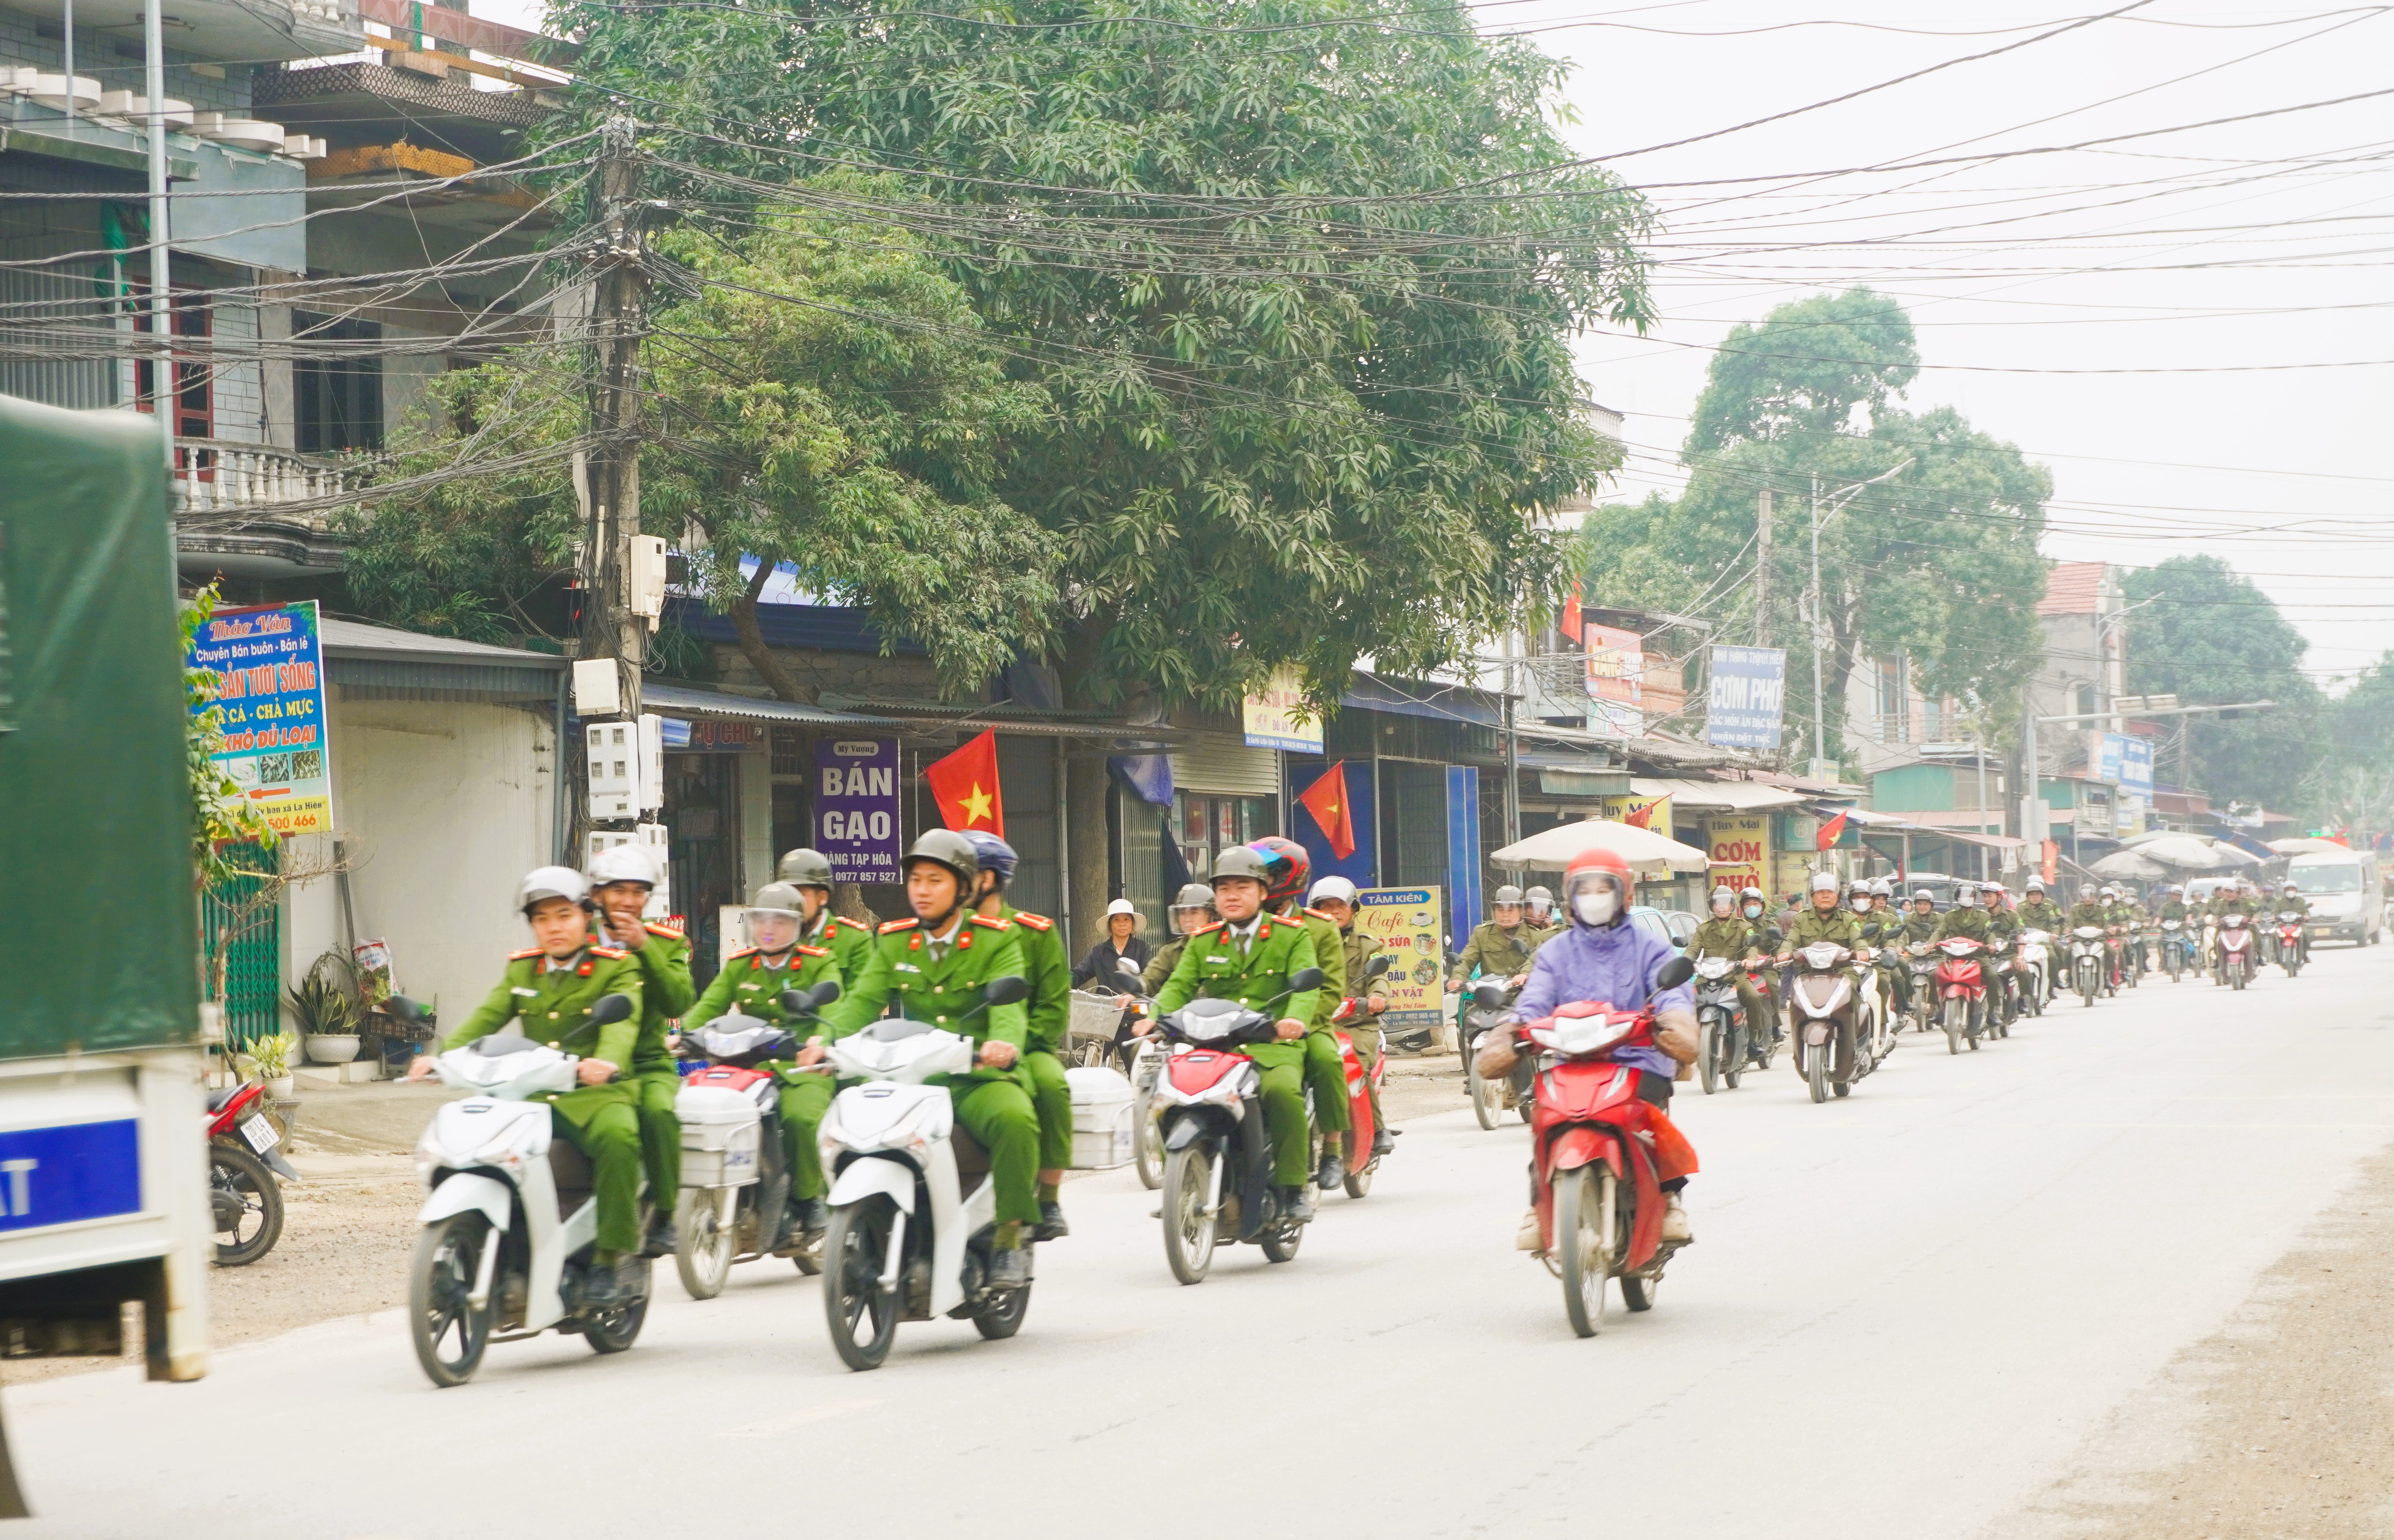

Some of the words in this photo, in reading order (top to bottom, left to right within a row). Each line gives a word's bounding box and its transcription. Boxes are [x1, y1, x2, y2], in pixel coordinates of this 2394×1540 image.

[210, 619, 252, 639] Thảo
[256, 615, 292, 633] Vân
[196, 647, 230, 663] Chuyên
[231, 643, 250, 658] Bán
[251, 641, 274, 656] buôn
[280, 638, 299, 652] Bán
[300, 636, 308, 651] lẻ
[247, 663, 277, 697] TƯƠI
[280, 653, 316, 694] SỐNG
[1710, 674, 1748, 710] CƠM
[1749, 666, 1783, 713] PHỞ
[229, 702, 246, 724] CÁ
[256, 697, 284, 720] CHẢ
[286, 699, 314, 719] MỰC
[1709, 713, 1723, 726] CÁC
[1724, 713, 1740, 727] MÓN
[1740, 714, 1751, 727] ĂN
[1751, 715, 1766, 730] ĐẶC
[223, 727, 255, 752] KHÔ
[257, 723, 278, 749] ĐỦ
[281, 724, 316, 749] LOẠI
[1710, 731, 1735, 743] NHẬN
[1736, 732, 1752, 744] ĐẶT
[838, 744, 849, 753] Mỹ
[851, 745, 875, 754] Vượng
[822, 761, 893, 796] BÁN
[267, 805, 280, 815] ban
[283, 803, 292, 812] xã
[294, 803, 303, 812] La
[305, 801, 322, 811] Hiên
[293, 813, 316, 828] 466
[823, 811, 891, 846] GẠO
[851, 853, 869, 867] TẠP
[872, 851, 892, 865] HÓA
[1714, 838, 1762, 862] CƠM
[835, 872, 857, 881] 0977
[860, 872, 877, 881] 857
[879, 872, 896, 882] 527
[1715, 866, 1760, 894] PHỞ
[1367, 894, 1394, 904] TÂM
[1396, 893, 1422, 903] KIÊN
[1356, 909, 1405, 933] Café
[1388, 934, 1411, 948] SỮA
[1387, 969, 1406, 984] ĐẬU
[1402, 986, 1424, 999] VẶT
